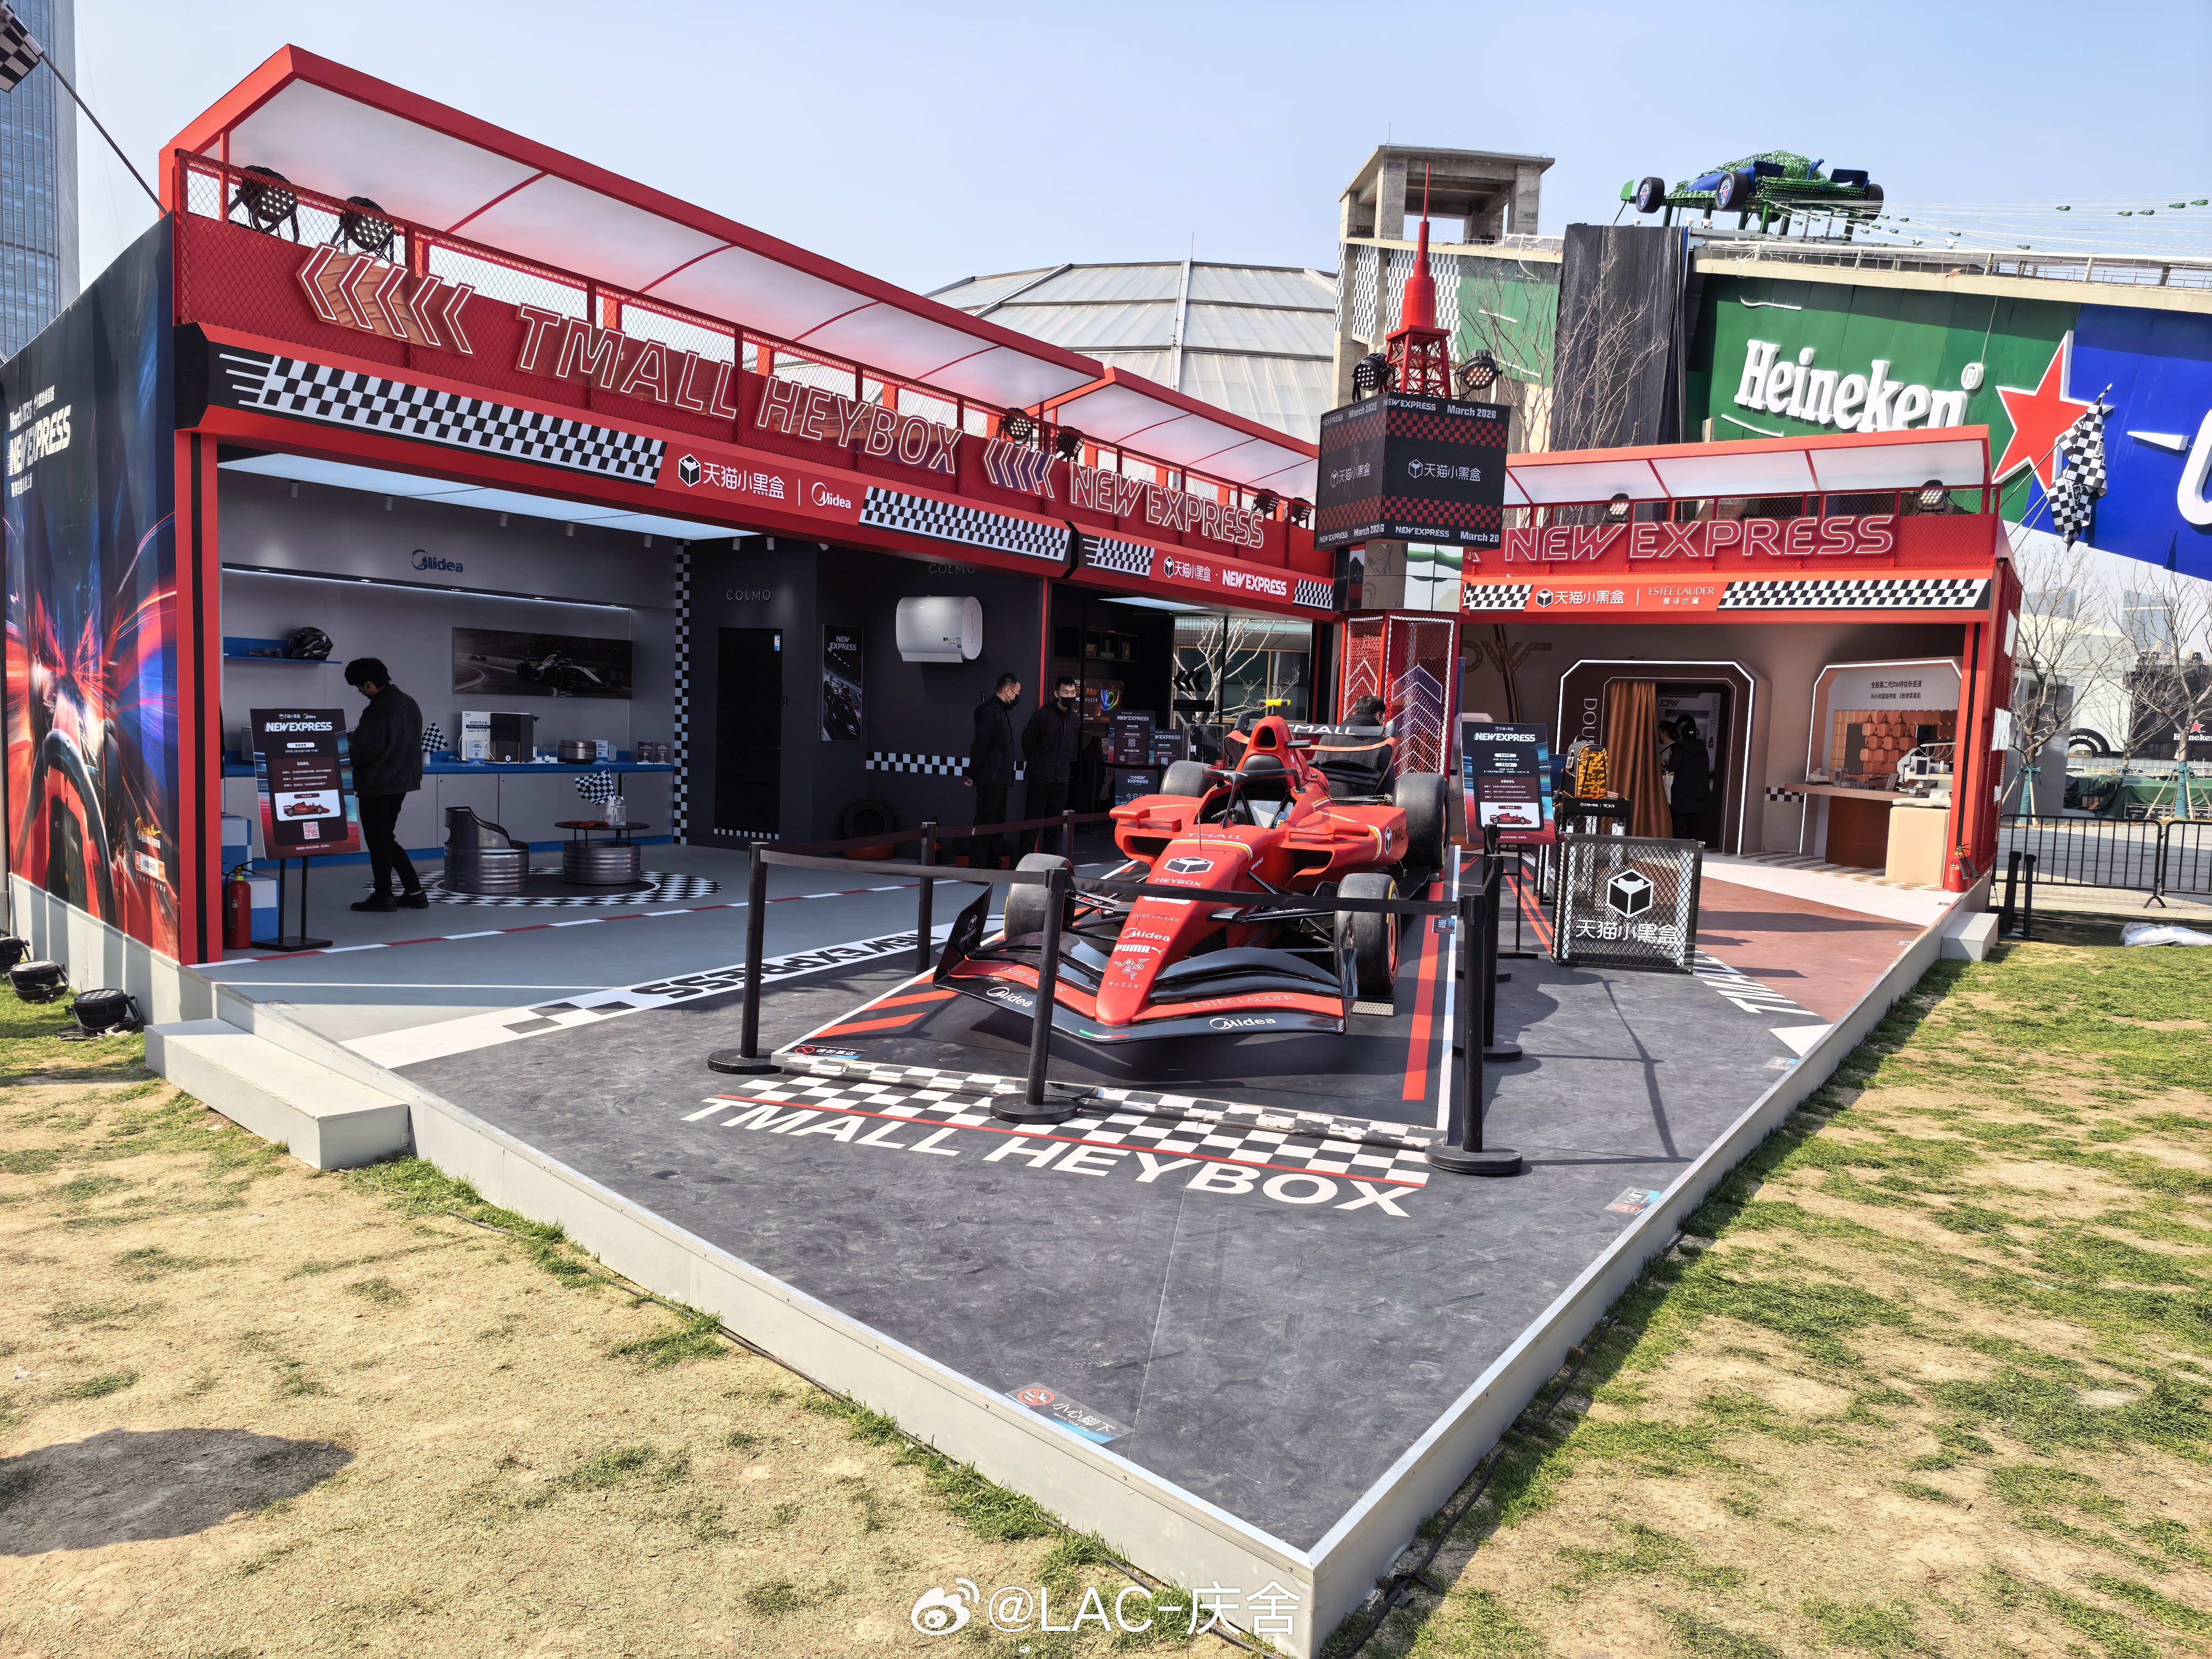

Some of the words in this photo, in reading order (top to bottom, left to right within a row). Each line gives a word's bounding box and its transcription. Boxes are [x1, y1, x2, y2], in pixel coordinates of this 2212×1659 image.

[520, 306, 737, 419] TMALL
[757, 376, 964, 474] HEYBOX
[1734, 340, 1968, 433] Heineken
[1349, 406, 1365, 419] March
[1366, 402, 1377, 413] 2026
[1447, 405, 1475, 416] March
[1477, 409, 1496, 419] 2026
[703, 462, 785, 500] 天猫小黑盒
[1338, 462, 1370, 483] 天猫小黑盒
[1424, 463, 1481, 482] 天猫小黑盒
[812, 482, 852, 510] Midea
[1071, 462, 1144, 517] NEW
[1147, 484, 1264, 549] EXPRESS
[1354, 527, 1370, 537] March
[1460, 531, 1488, 542] March
[1489, 534, 1499, 543] 20
[1505, 524, 1626, 561] NEW
[1630, 516, 1893, 558] EXPRESS
[410, 549, 463, 572] Midea
[1174, 559, 1211, 583] 天猫小黑盒
[726, 590, 771, 601] COLMO
[1555, 590, 1625, 605] 天猫小黑盒
[1677, 587, 1715, 596] LAUDER
[1663, 597, 1700, 605] 雅诗兰黛
[830, 643, 857, 651] EXPRESS
[1155, 878, 1203, 887] HEYBOX
[1152, 914, 1180, 922] LAUDER
[1121, 928, 1171, 942] Midea
[1575, 919, 1681, 945] 天猫小黑盒
[1114, 944, 1151, 954] PUMA
[1026, 975, 1068, 993] LAER
[987, 987, 1033, 1007] Midea
[1238, 994, 1296, 1003] LAUDER
[1209, 1017, 1277, 1029] Midea
[679, 1097, 961, 1156] TMALL
[982, 1142, 1415, 1217] HEYBOX
[1053, 1403, 1116, 1432] 小心脚下
